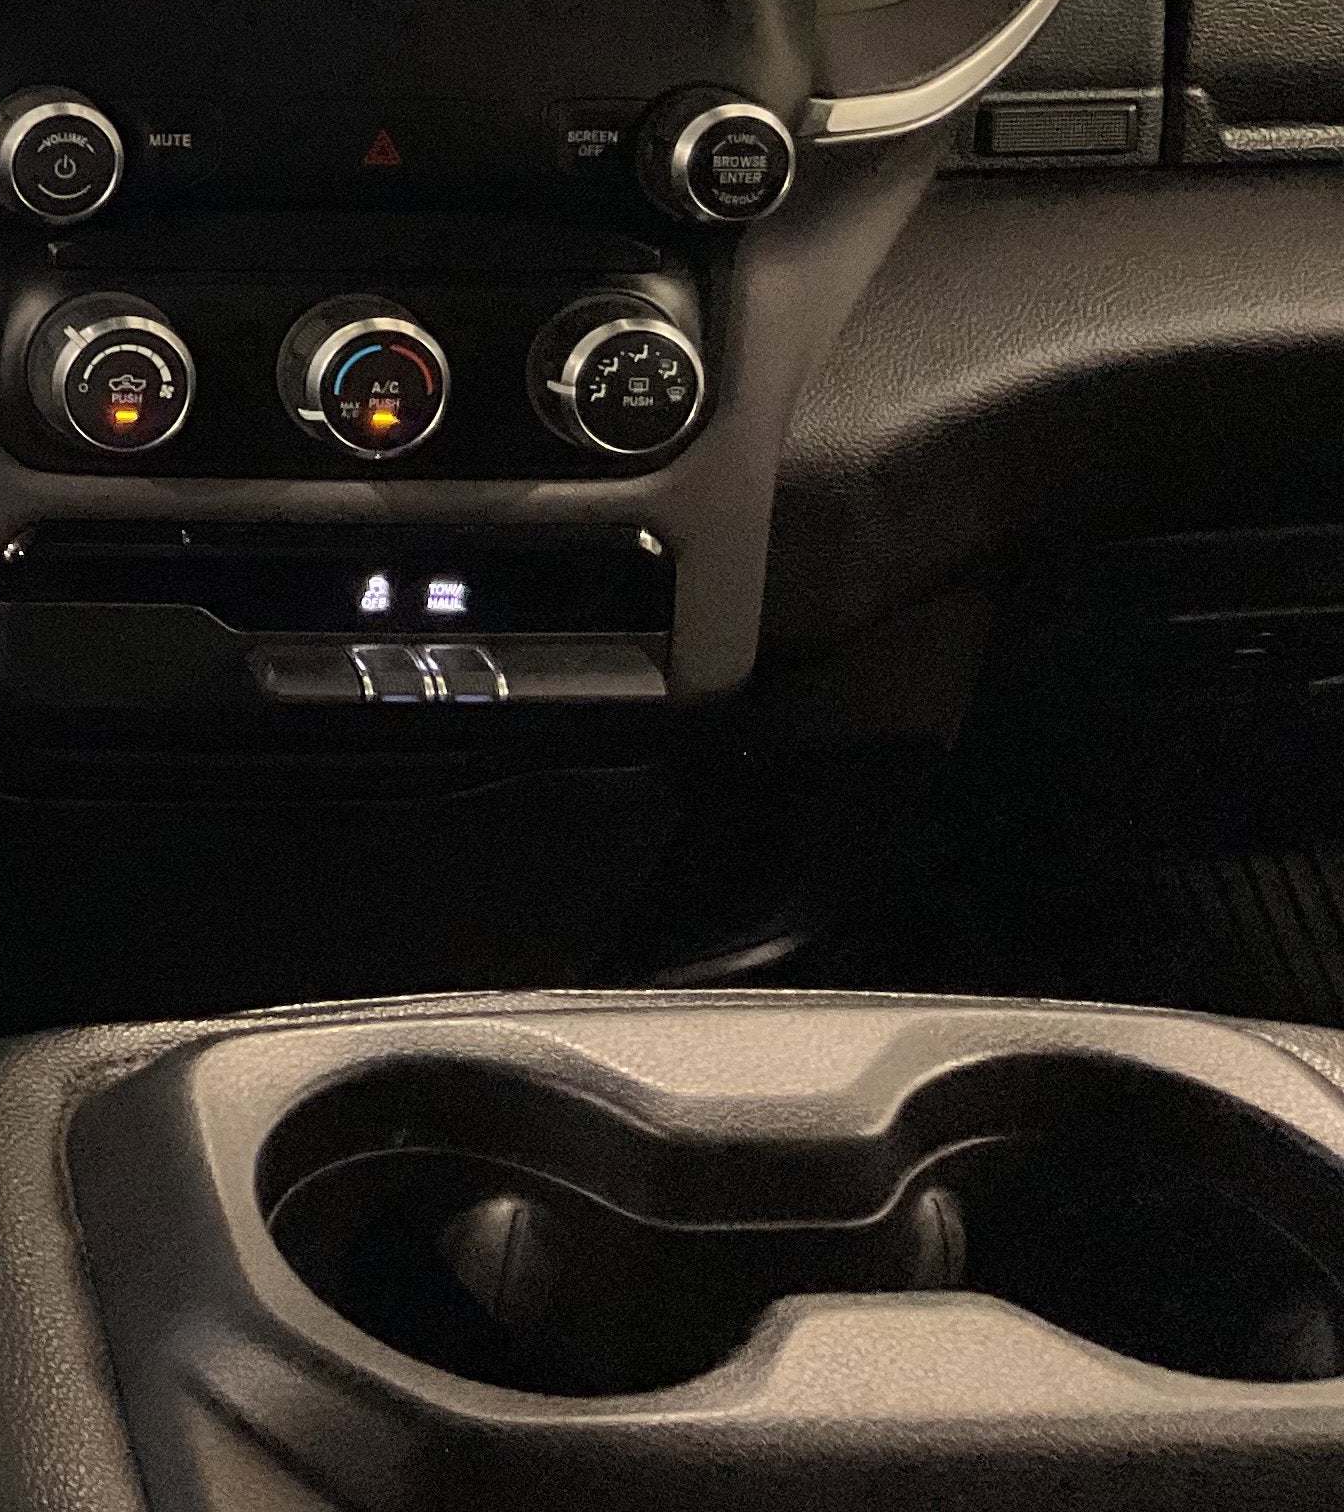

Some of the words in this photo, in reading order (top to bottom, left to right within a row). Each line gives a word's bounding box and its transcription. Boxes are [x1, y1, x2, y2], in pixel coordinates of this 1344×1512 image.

[42, 132, 89, 149] VOLUME
[148, 133, 192, 149] MUTE
[567, 130, 619, 144] SCREEN
[578, 144, 605, 157] OFF
[713, 155, 768, 168] BROWSE
[719, 171, 762, 184] ENTER
[371, 380, 400, 394] A/C
[111, 392, 143, 404] PUSH
[623, 395, 654, 407] PUSH
[361, 597, 387, 609] OFF
[427, 597, 463, 609] HAUL
